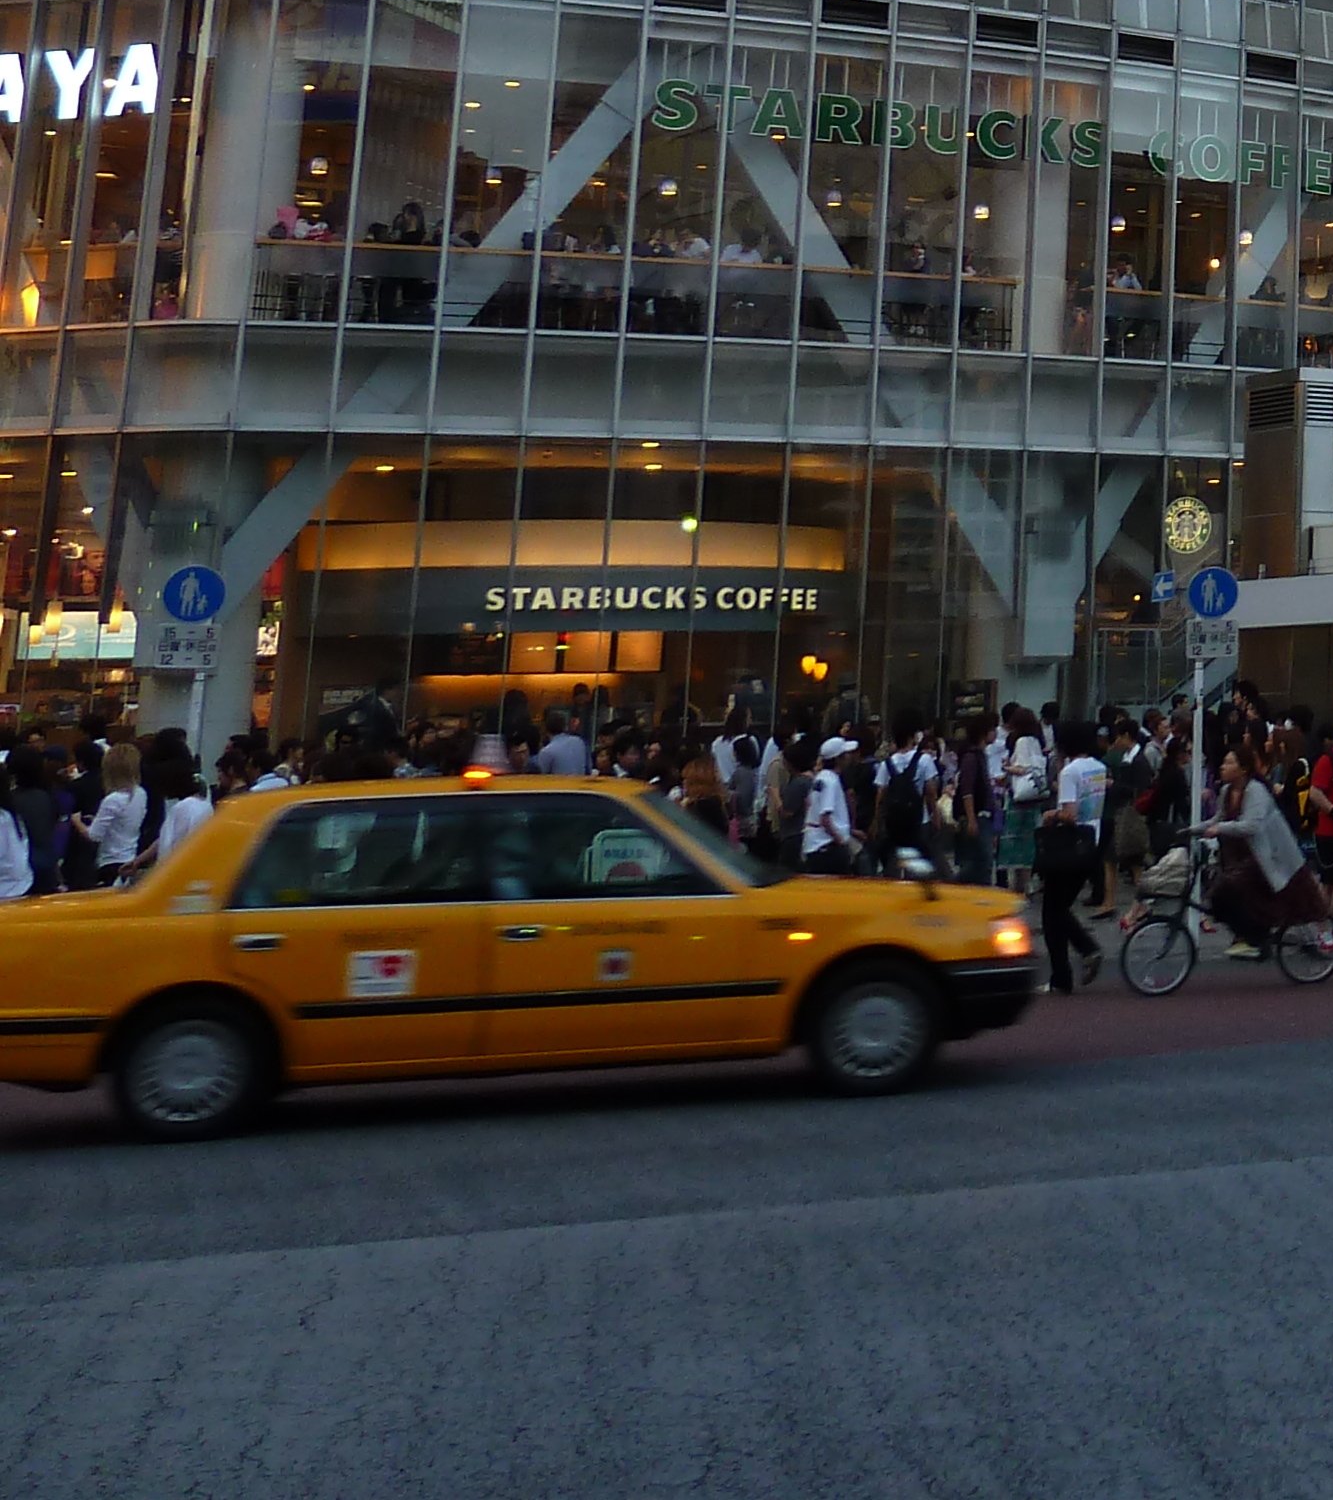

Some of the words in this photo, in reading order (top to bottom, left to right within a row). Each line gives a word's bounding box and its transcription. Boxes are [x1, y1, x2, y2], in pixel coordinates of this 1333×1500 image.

[652, 78, 1103, 168] STARBUCKS
[485, 586, 707, 611] STARBUCKS
[716, 587, 818, 611] COFFEE
